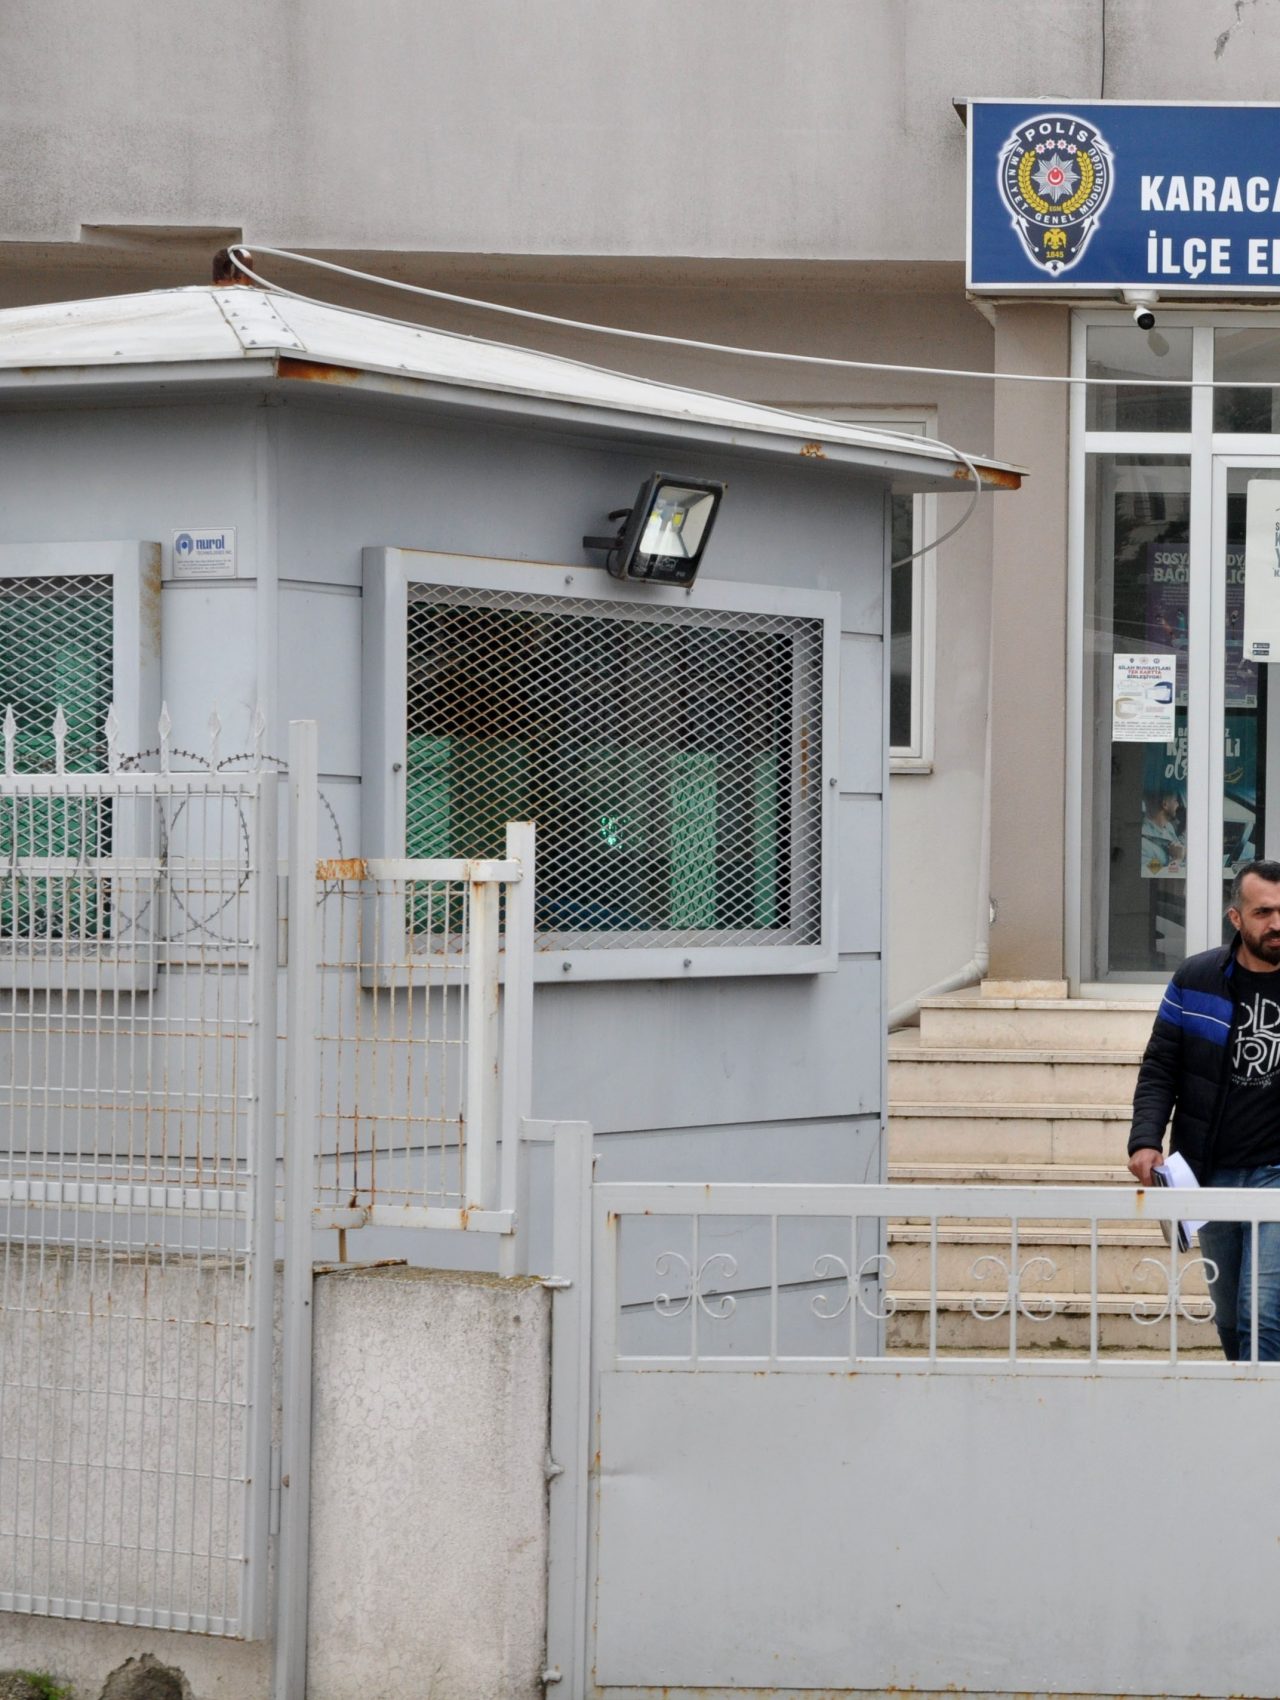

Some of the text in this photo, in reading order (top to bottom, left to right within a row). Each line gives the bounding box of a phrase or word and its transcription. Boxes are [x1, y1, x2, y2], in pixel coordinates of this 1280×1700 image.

[1024, 121, 1089, 143] POLİS
[1034, 212, 1076, 224] GENEL
[1147, 230, 1231, 279] İLÇE
[196, 534, 225, 549] nurol
